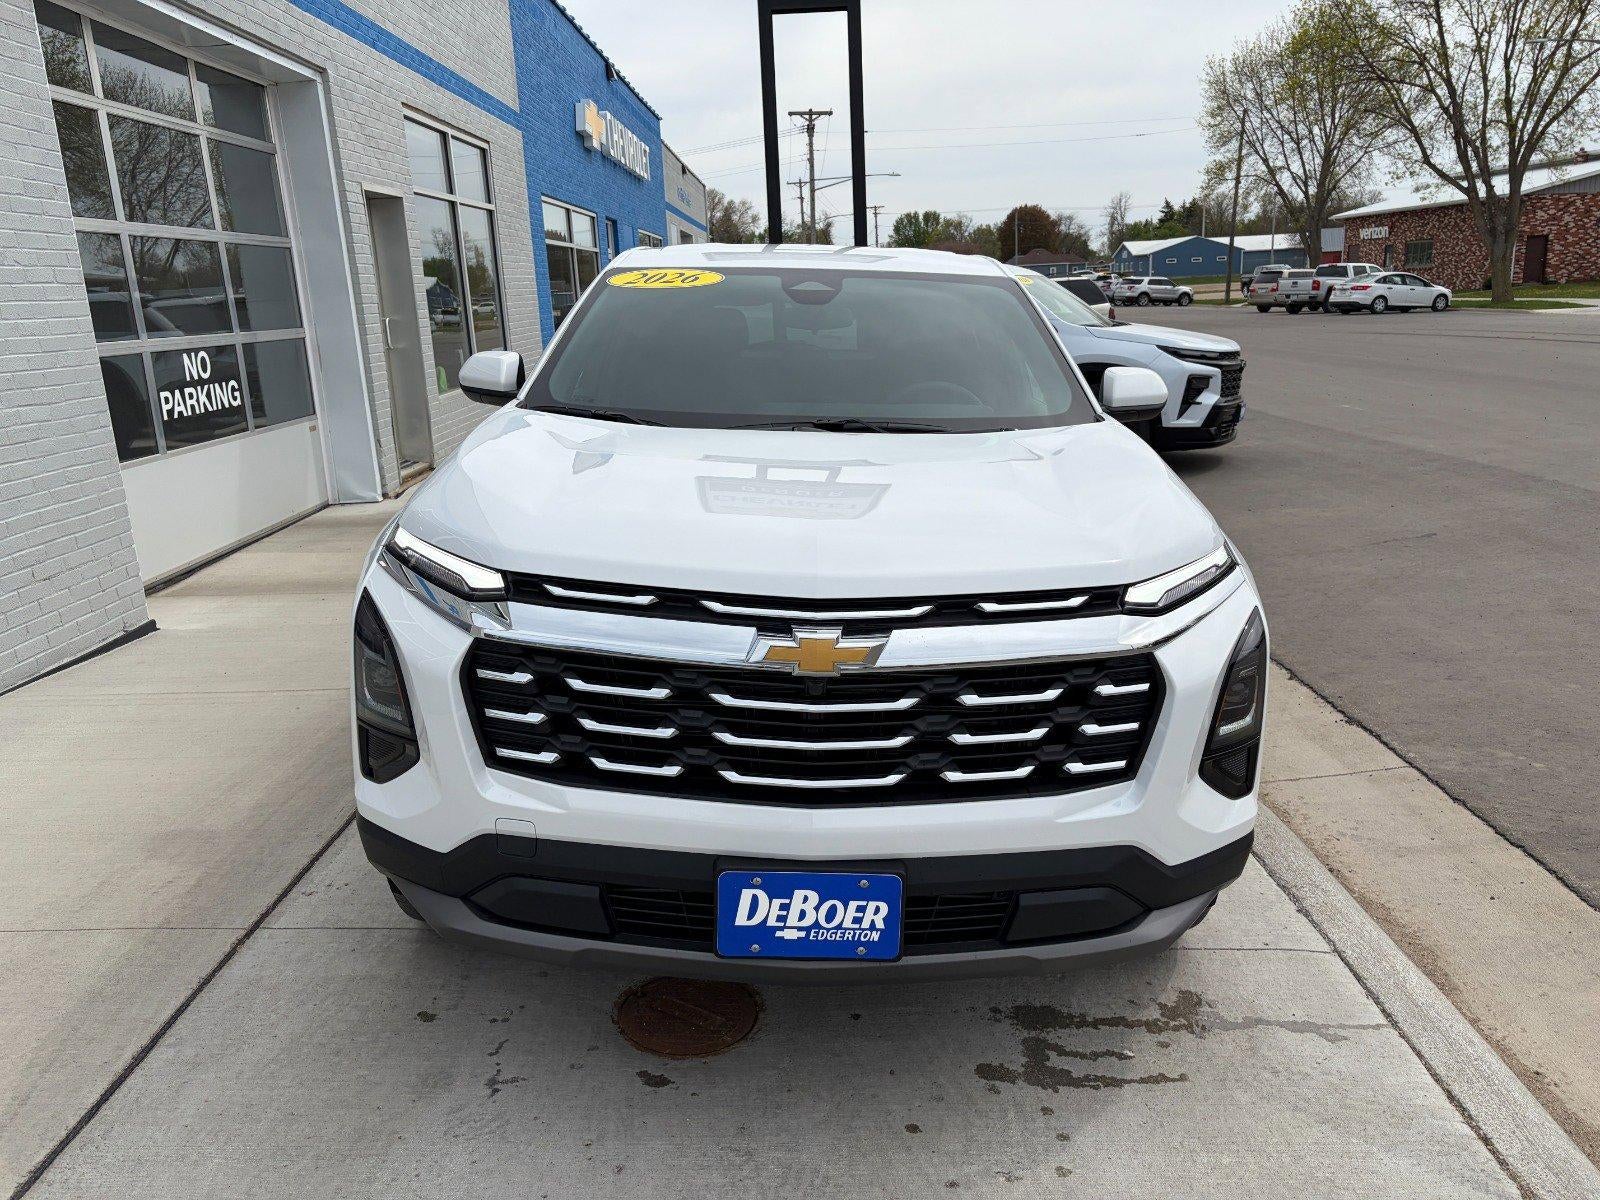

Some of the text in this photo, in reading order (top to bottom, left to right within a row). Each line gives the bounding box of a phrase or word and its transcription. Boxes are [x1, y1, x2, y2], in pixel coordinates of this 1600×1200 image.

[1360, 224, 1389, 239] verizon
[623, 271, 707, 285] 2026
[182, 350, 211, 381] NO
[159, 380, 242, 420] PARKING
[809, 929, 881, 942] EDGERTON
